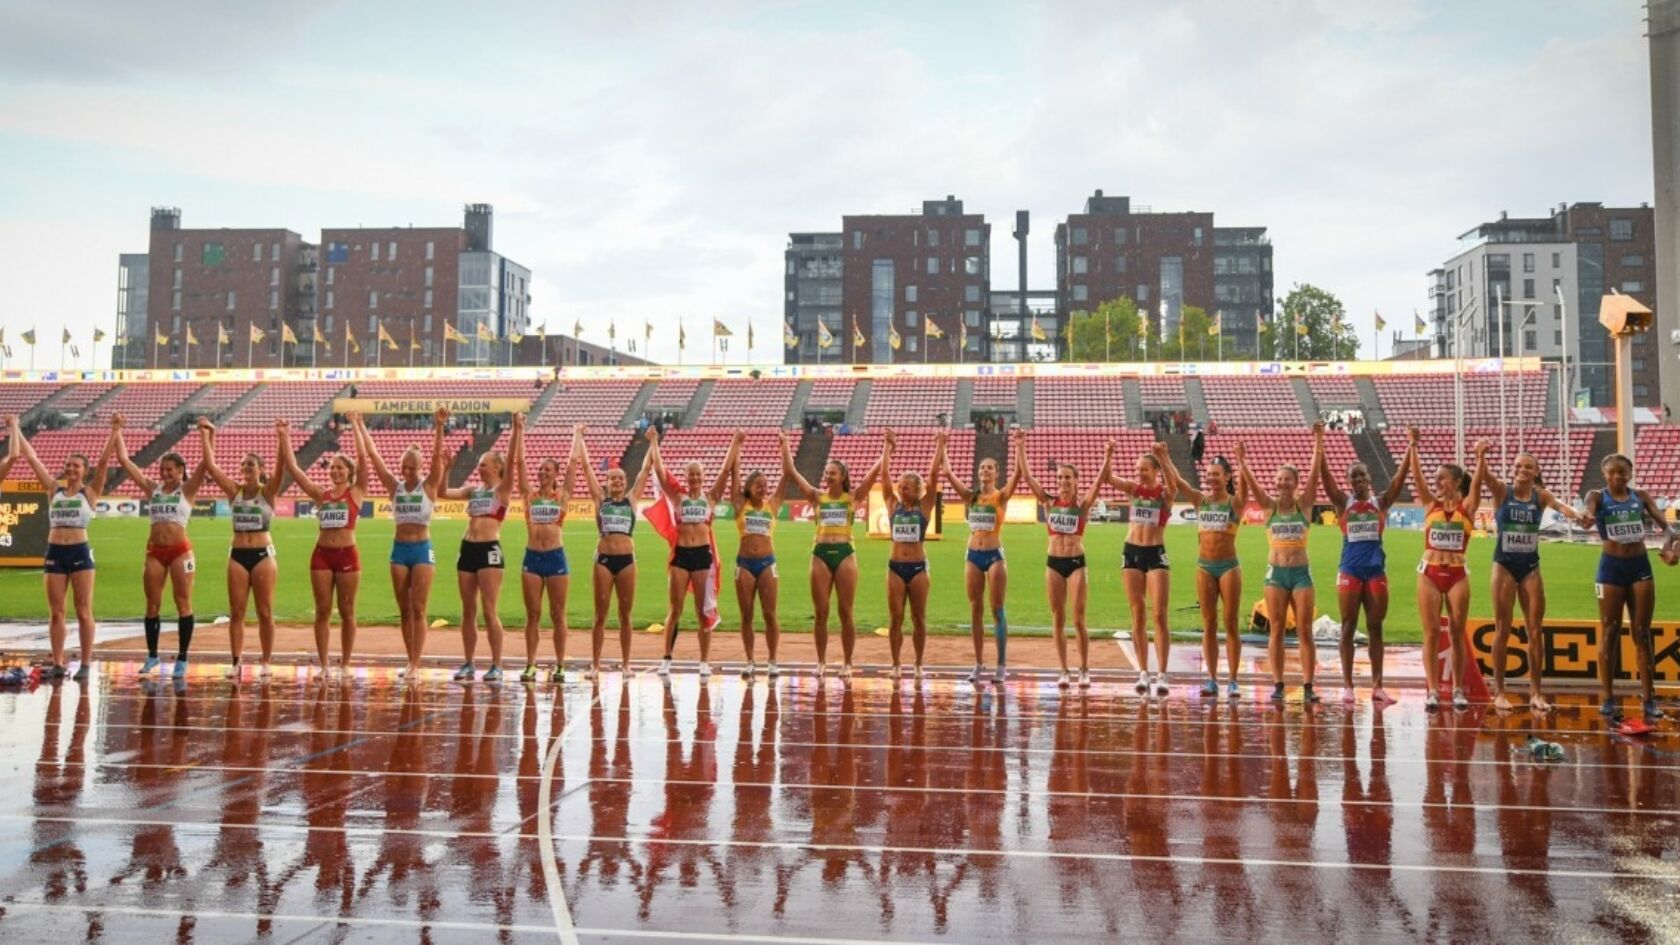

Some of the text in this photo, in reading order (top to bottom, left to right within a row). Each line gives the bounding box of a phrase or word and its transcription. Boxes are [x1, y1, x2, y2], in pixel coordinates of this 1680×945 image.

[374, 400, 491, 411] TAMPERE STADION
[13, 503, 39, 514] JUMP
[1135, 508, 1153, 519] REY
[320, 511, 347, 521] LANGE
[1510, 508, 1533, 523] USA
[1608, 523, 1642, 537] LESTER
[1431, 531, 1463, 543] CONTE
[1507, 534, 1534, 545] HALL
[491, 553, 498, 562] 2
[187, 562, 194, 571] 6
